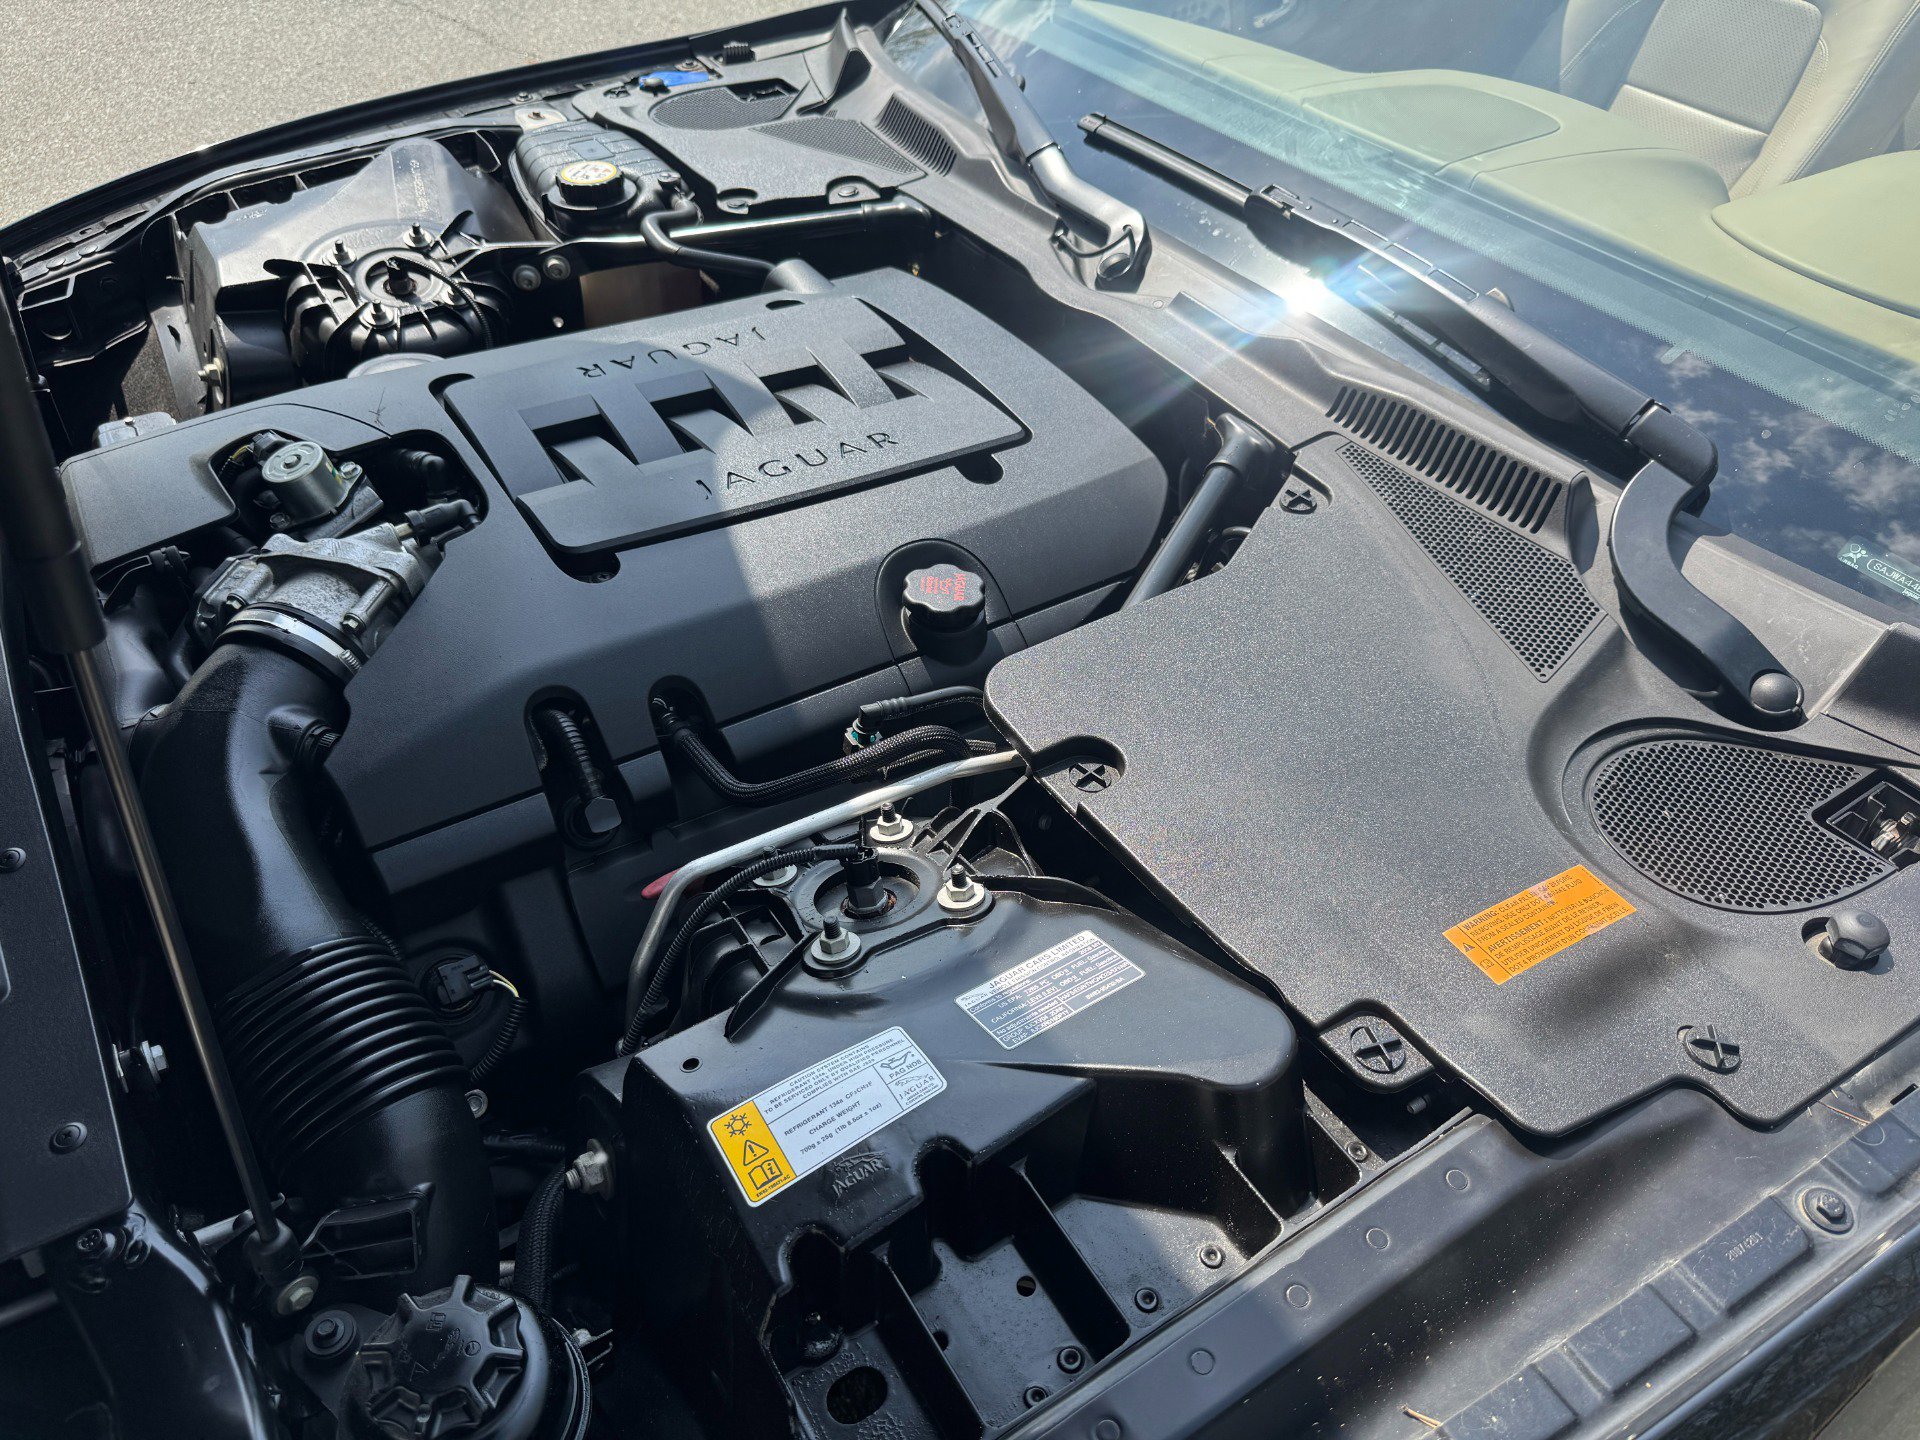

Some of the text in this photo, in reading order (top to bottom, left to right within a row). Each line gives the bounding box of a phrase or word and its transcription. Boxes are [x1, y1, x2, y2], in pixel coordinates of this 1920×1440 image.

[576, 327, 766, 378] JAGUAR
[695, 432, 898, 500] JAGUAR
[1461, 908, 1500, 930] WARNING:
[1497, 899, 1520, 912] CLEAN
[1501, 910, 1517, 920] USE
[1513, 902, 1532, 914] ONLY
[1528, 896, 1545, 906] DOT
[1564, 878, 1583, 889] FLUID
[1475, 930, 1497, 943] FROM
[1498, 916, 1525, 931] SEALED
[1485, 919, 1546, 952] AVERTISSEMENT
[1545, 902, 1578, 921] NETTOYER
[1580, 886, 1610, 904] BOUCHON
[1493, 950, 1506, 959] DE
[1501, 929, 1546, 954] REMPLISSAGE
[1542, 919, 1564, 933] AVANT
[1560, 915, 1572, 923] DE
[1500, 947, 1530, 966] UTILISER
[1526, 928, 1566, 951] UNIQUEMENT
[1562, 923, 1576, 932] DU
[1592, 909, 1604, 917] DE
[1600, 901, 1620, 913] FREIN
[986, 935, 1086, 989] JAGUAR CARS LIMITED
[1507, 961, 1525, 972] DOT
[1525, 940, 1564, 963] PROVENANT
[968, 996, 996, 1013] Conforms
[995, 1027, 1007, 1035] No
[1036, 999, 1059, 1013] needed
[996, 1000, 1008, 1008] US
[768, 1078, 812, 1104] REFRIGERANT
[827, 1060, 848, 1073] UNDER
[848, 1052, 863, 1062] HIGH
[863, 1037, 893, 1055] PRESSURE
[783, 1084, 814, 1103] SERVICED
[813, 1075, 830, 1086] ONLY
[830, 1069, 840, 1077] BY
[839, 1054, 870, 1072] QUALIFIED
[870, 1038, 904, 1057] PERSONNEL
[788, 1043, 869, 1086] CAUTION SYSTEM CONTAINS
[801, 1080, 833, 1099] COMPLIES
[832, 1071, 848, 1081] WITH
[848, 1064, 861, 1073] SAE
[888, 1058, 922, 1079] PAG ND8
[897, 1074, 935, 1099] JAGUAR
[782, 1106, 829, 1136] REFRIGERANT
[828, 1097, 844, 1109] 134a
[807, 1100, 862, 1135] CHARGE WEIGHT
[799, 1141, 816, 1155] 700g
[820, 1131, 833, 1142] 25g
[831, 1159, 889, 1198] JAGUAR
